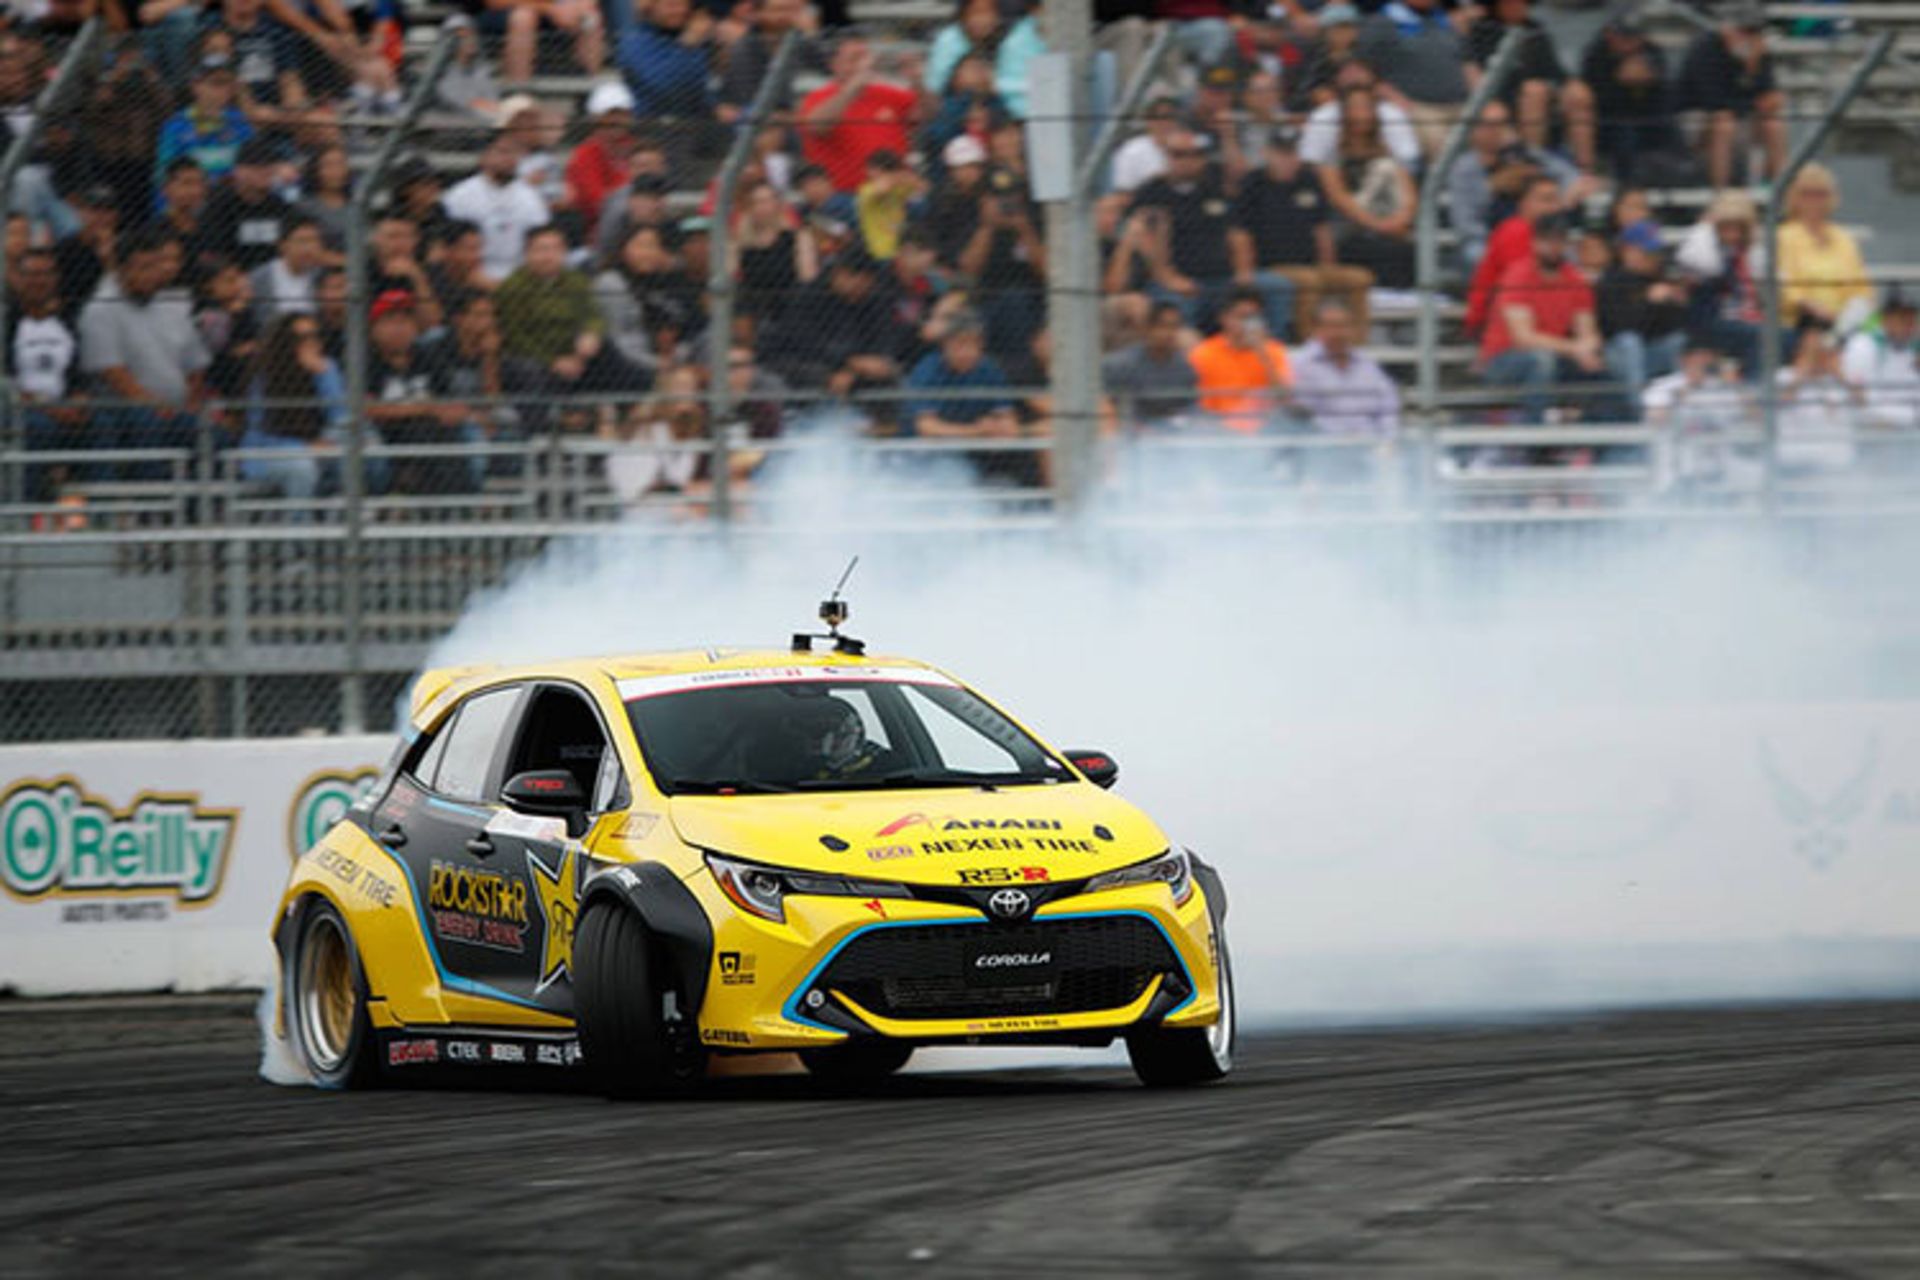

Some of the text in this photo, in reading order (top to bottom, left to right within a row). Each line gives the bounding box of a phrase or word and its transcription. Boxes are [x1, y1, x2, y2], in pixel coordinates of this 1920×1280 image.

[942, 819, 1062, 831] ANABI
[5, 797, 219, 888] O'Reilly
[920, 837, 1025, 855] NEXEN
[1028, 837, 1098, 854] TIRE
[357, 868, 397, 910] TIRE
[974, 952, 1051, 968] COROLLA
